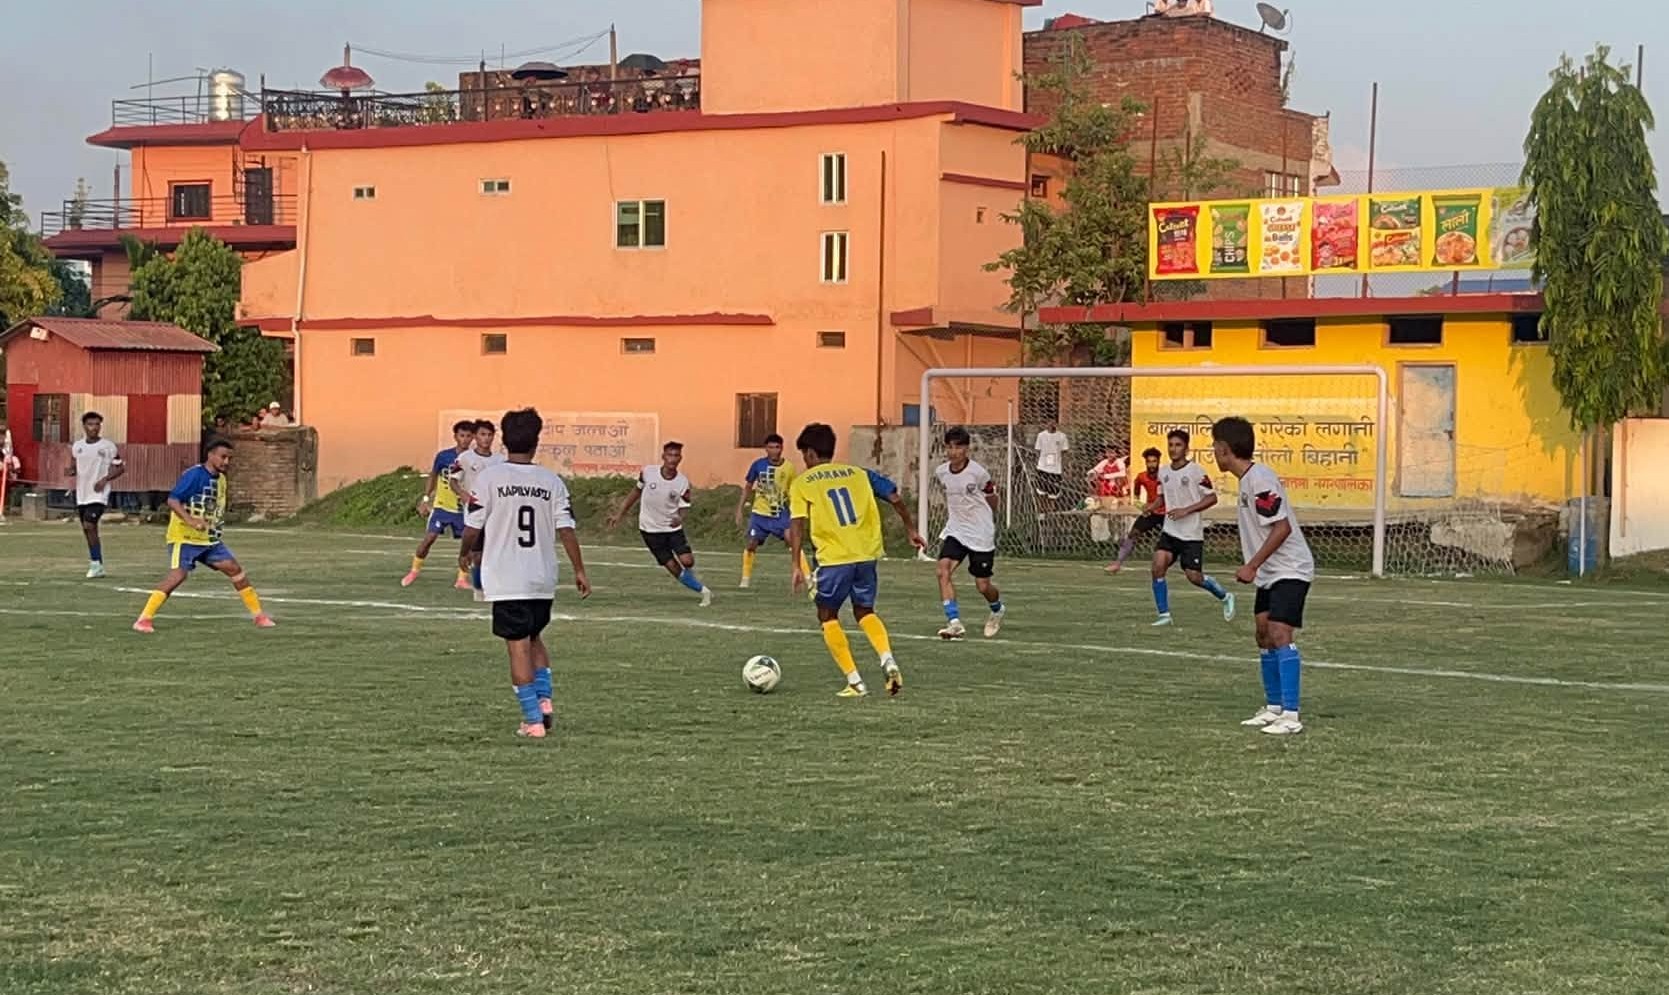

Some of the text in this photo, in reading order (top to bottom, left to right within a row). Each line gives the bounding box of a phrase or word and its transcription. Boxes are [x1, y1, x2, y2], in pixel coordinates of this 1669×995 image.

[1224, 231, 1235, 263] CHIPS
[1260, 416, 1308, 439] गरेको
[1315, 416, 1375, 438] लगानी
[826, 487, 857, 526] 11
[518, 505, 536, 548] 9
